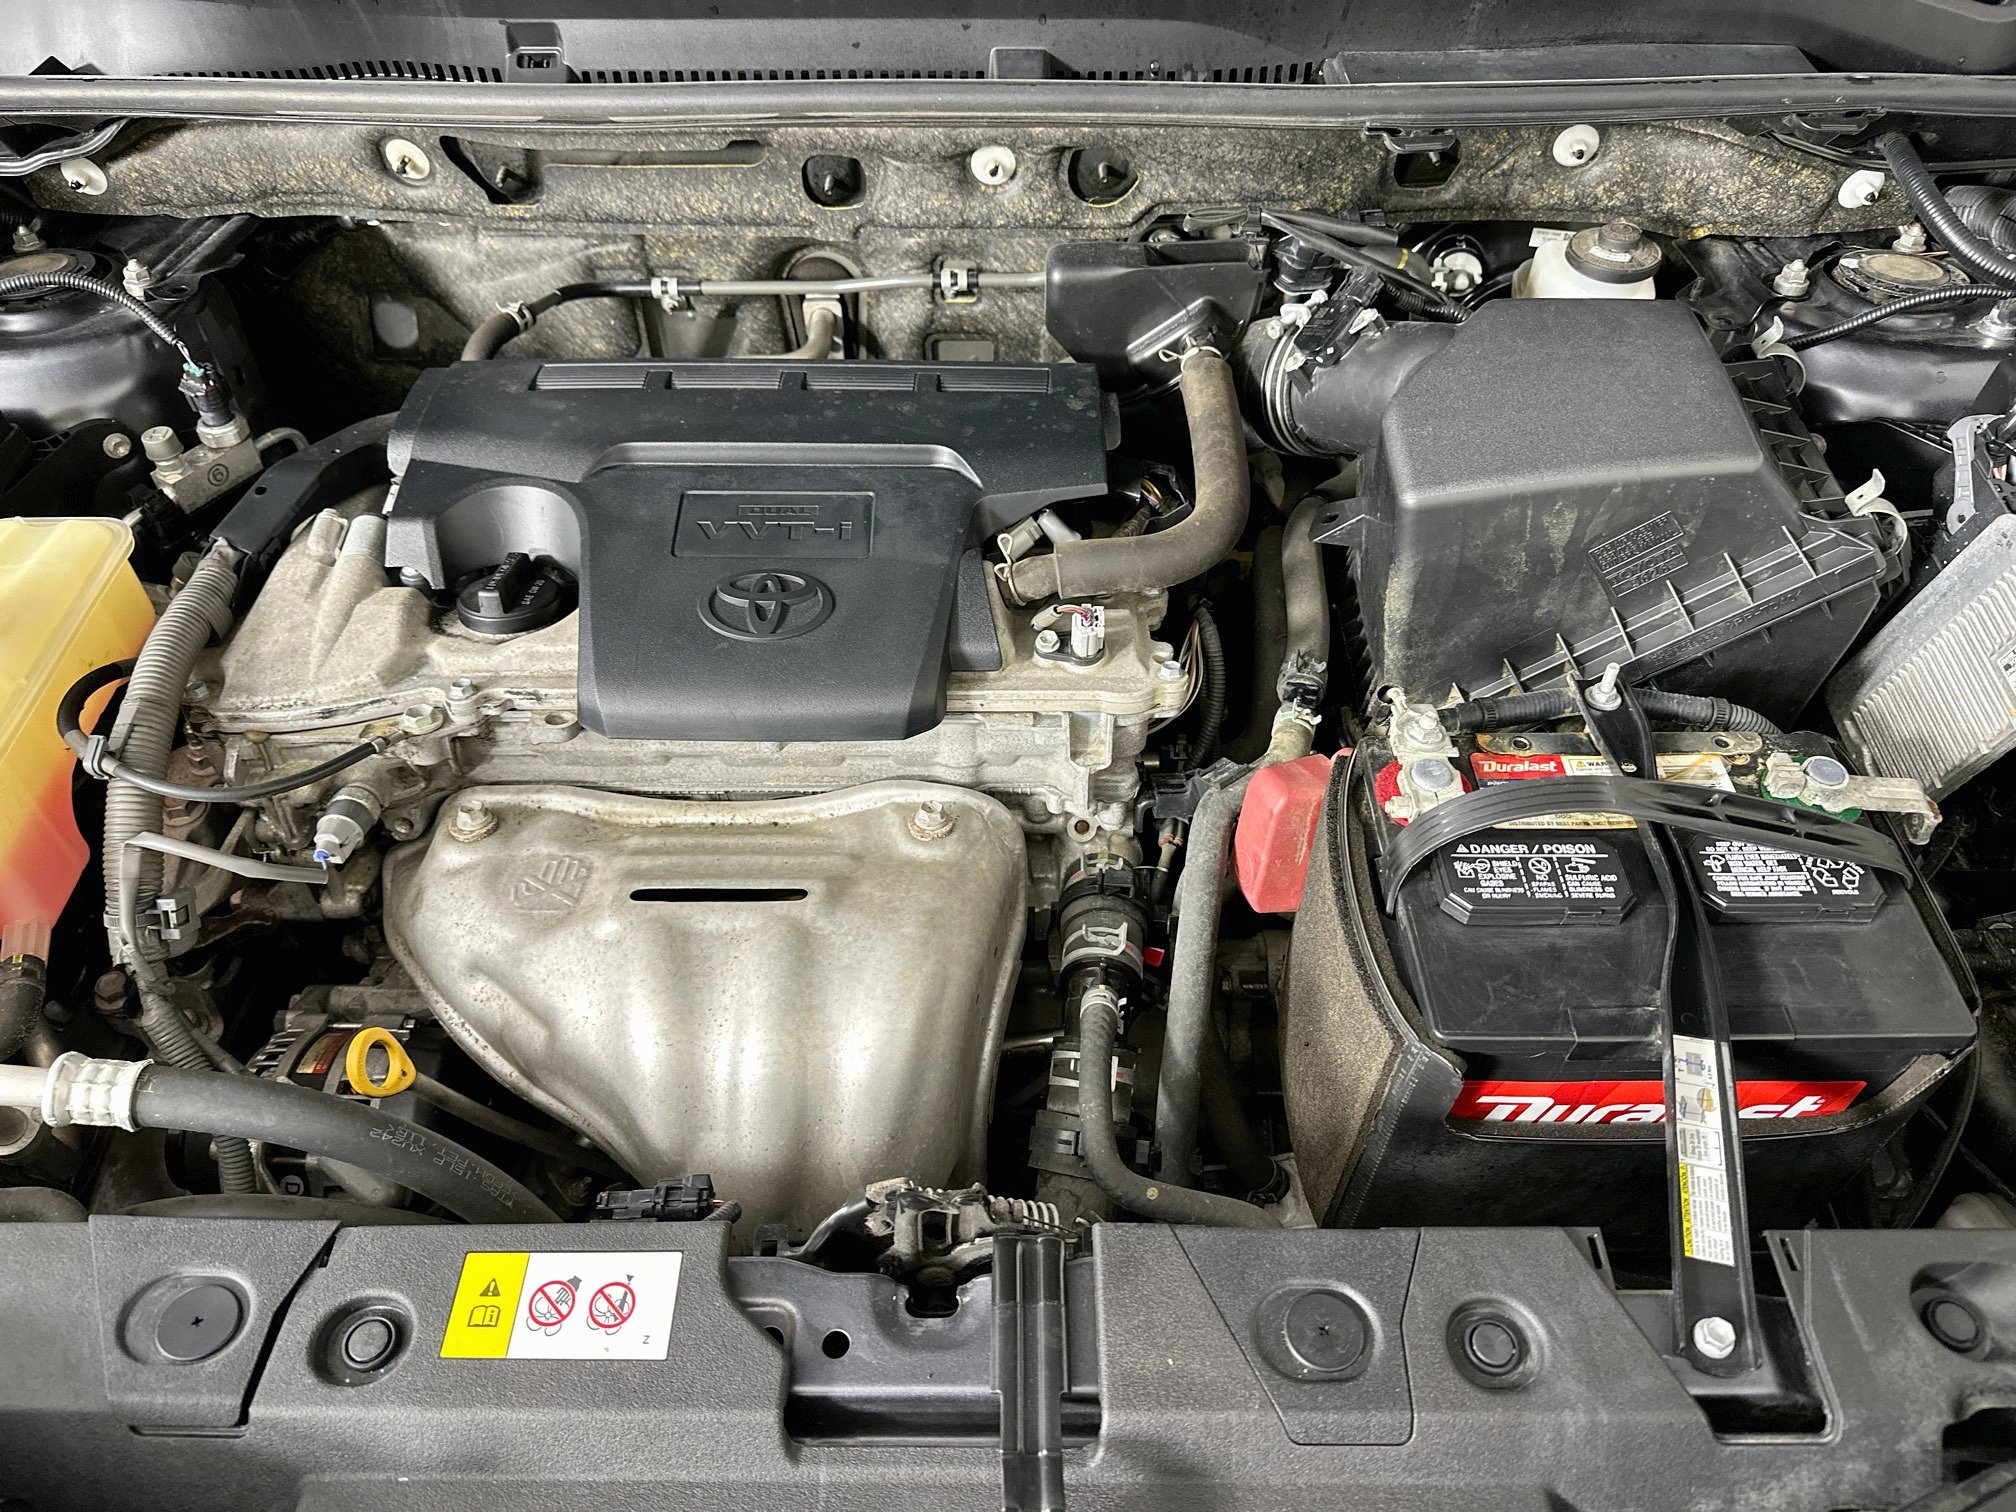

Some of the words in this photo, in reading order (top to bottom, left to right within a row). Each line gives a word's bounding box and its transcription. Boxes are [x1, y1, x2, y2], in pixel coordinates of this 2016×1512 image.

[697, 521, 852, 540] VVT-i
[1478, 760, 1558, 773] Duralast
[1469, 844, 1529, 854] DANGER
[1532, 844, 1540, 854] /
[1542, 843, 1597, 854] POISON
[1535, 873, 1549, 881] NO
[1564, 873, 1600, 881] SULFURIC
[1600, 873, 1618, 882] ACID
[369, 1127, 426, 1156] XU242
